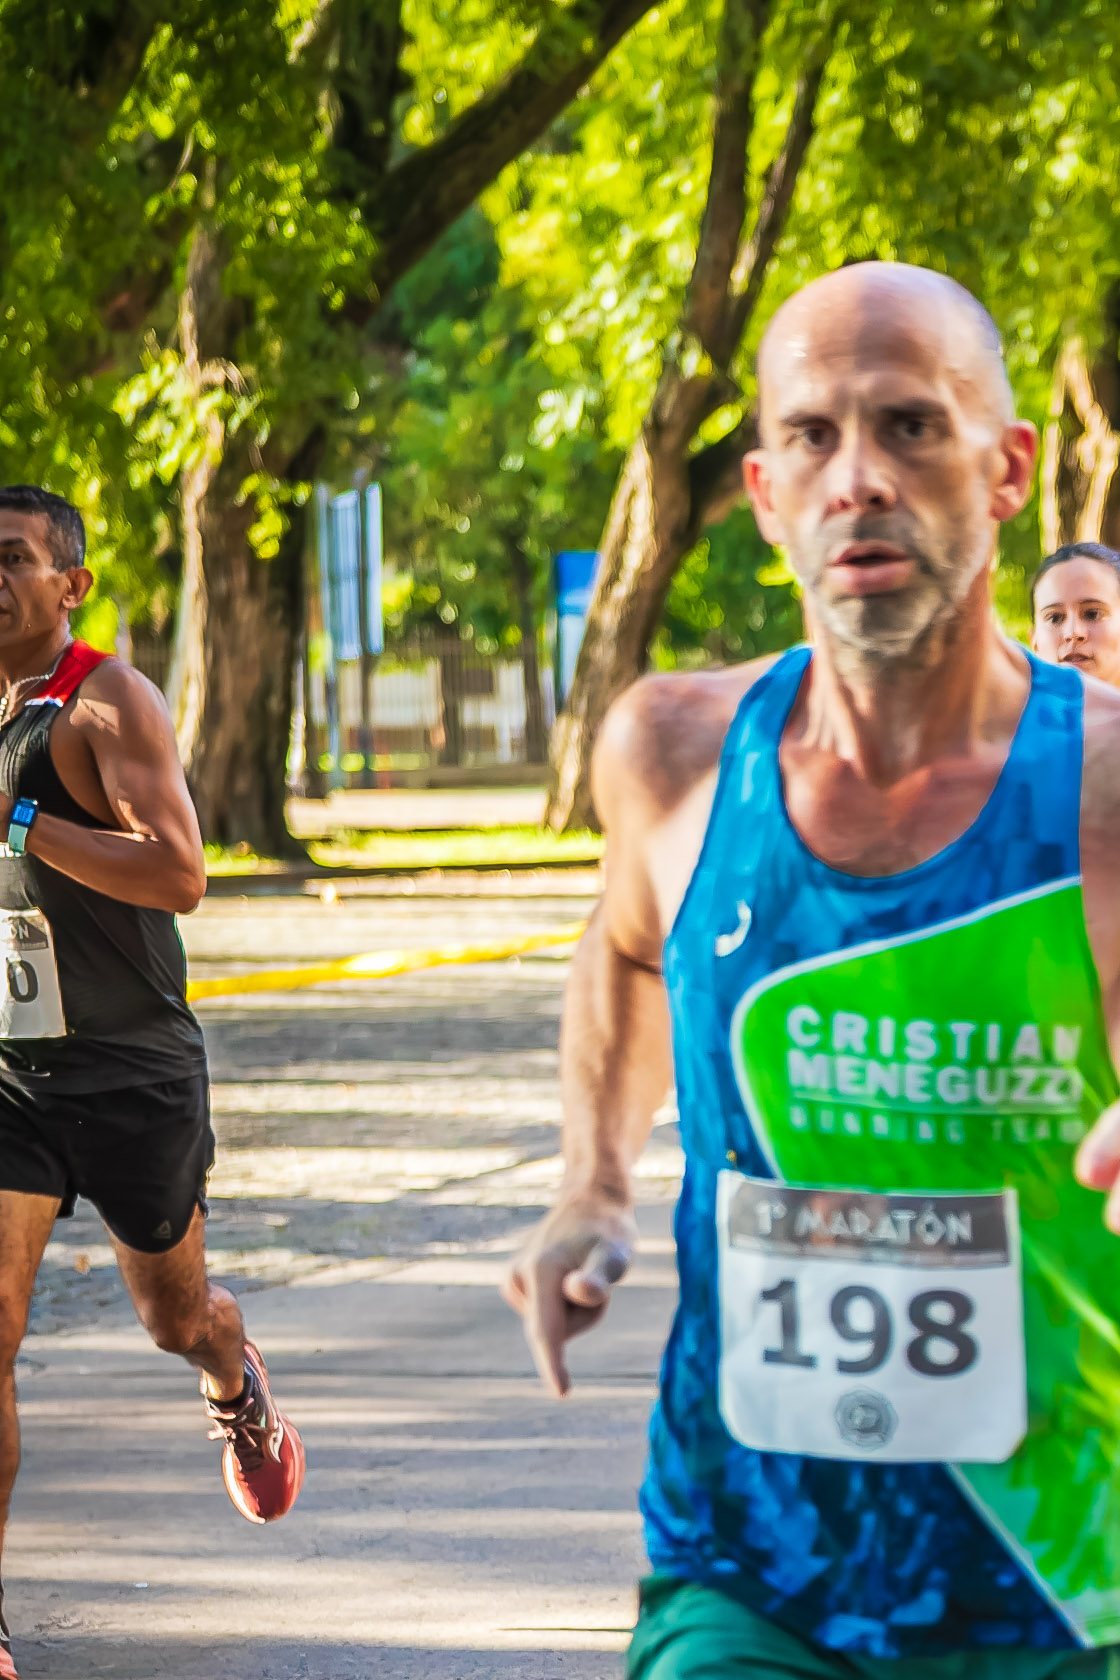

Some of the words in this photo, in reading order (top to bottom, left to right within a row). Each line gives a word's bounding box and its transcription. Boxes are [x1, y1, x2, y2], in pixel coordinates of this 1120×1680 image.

[787, 1005, 1081, 1063] CRISTIAN
[794, 1201, 973, 1246] MARATÓN
[760, 1279, 978, 1376] 198
